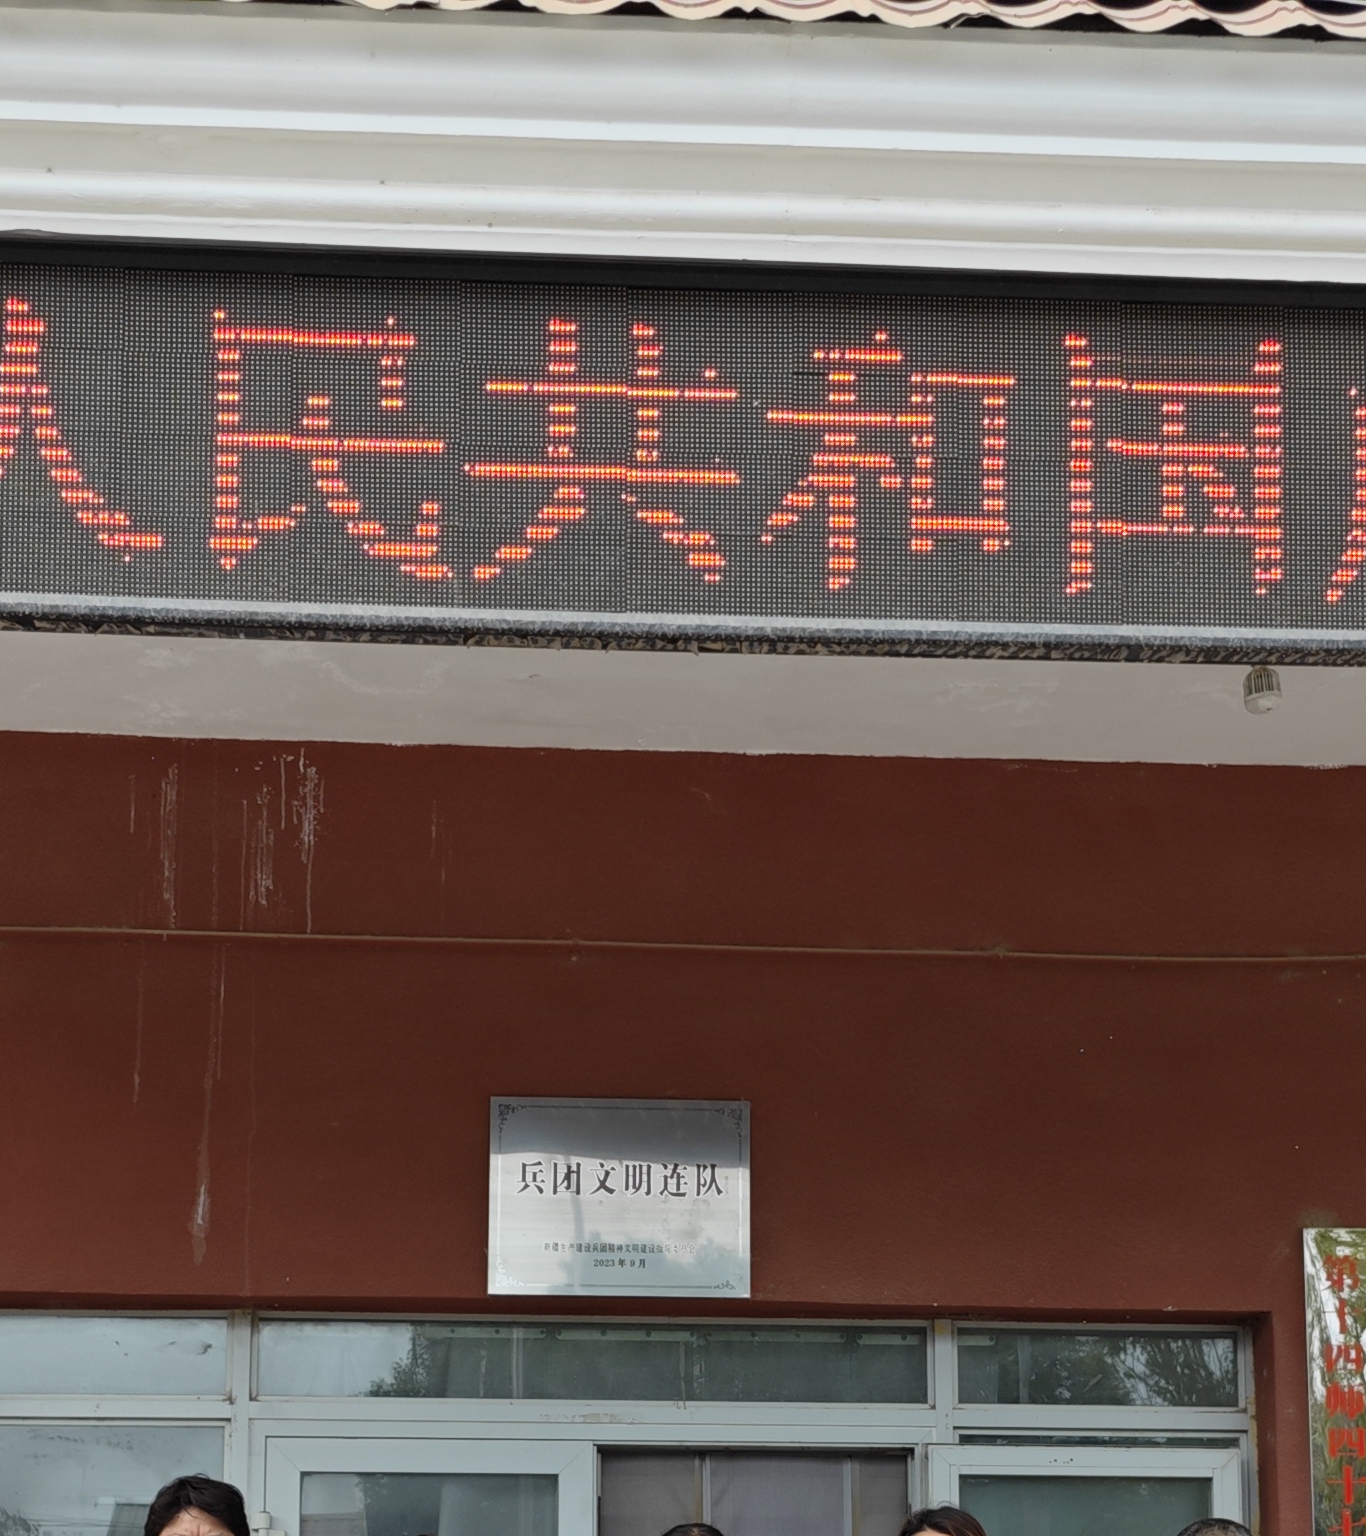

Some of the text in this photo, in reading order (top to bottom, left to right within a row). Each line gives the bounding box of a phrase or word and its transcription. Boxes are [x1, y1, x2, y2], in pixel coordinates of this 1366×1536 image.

[516, 1160, 724, 1197] 兵团文明连队
